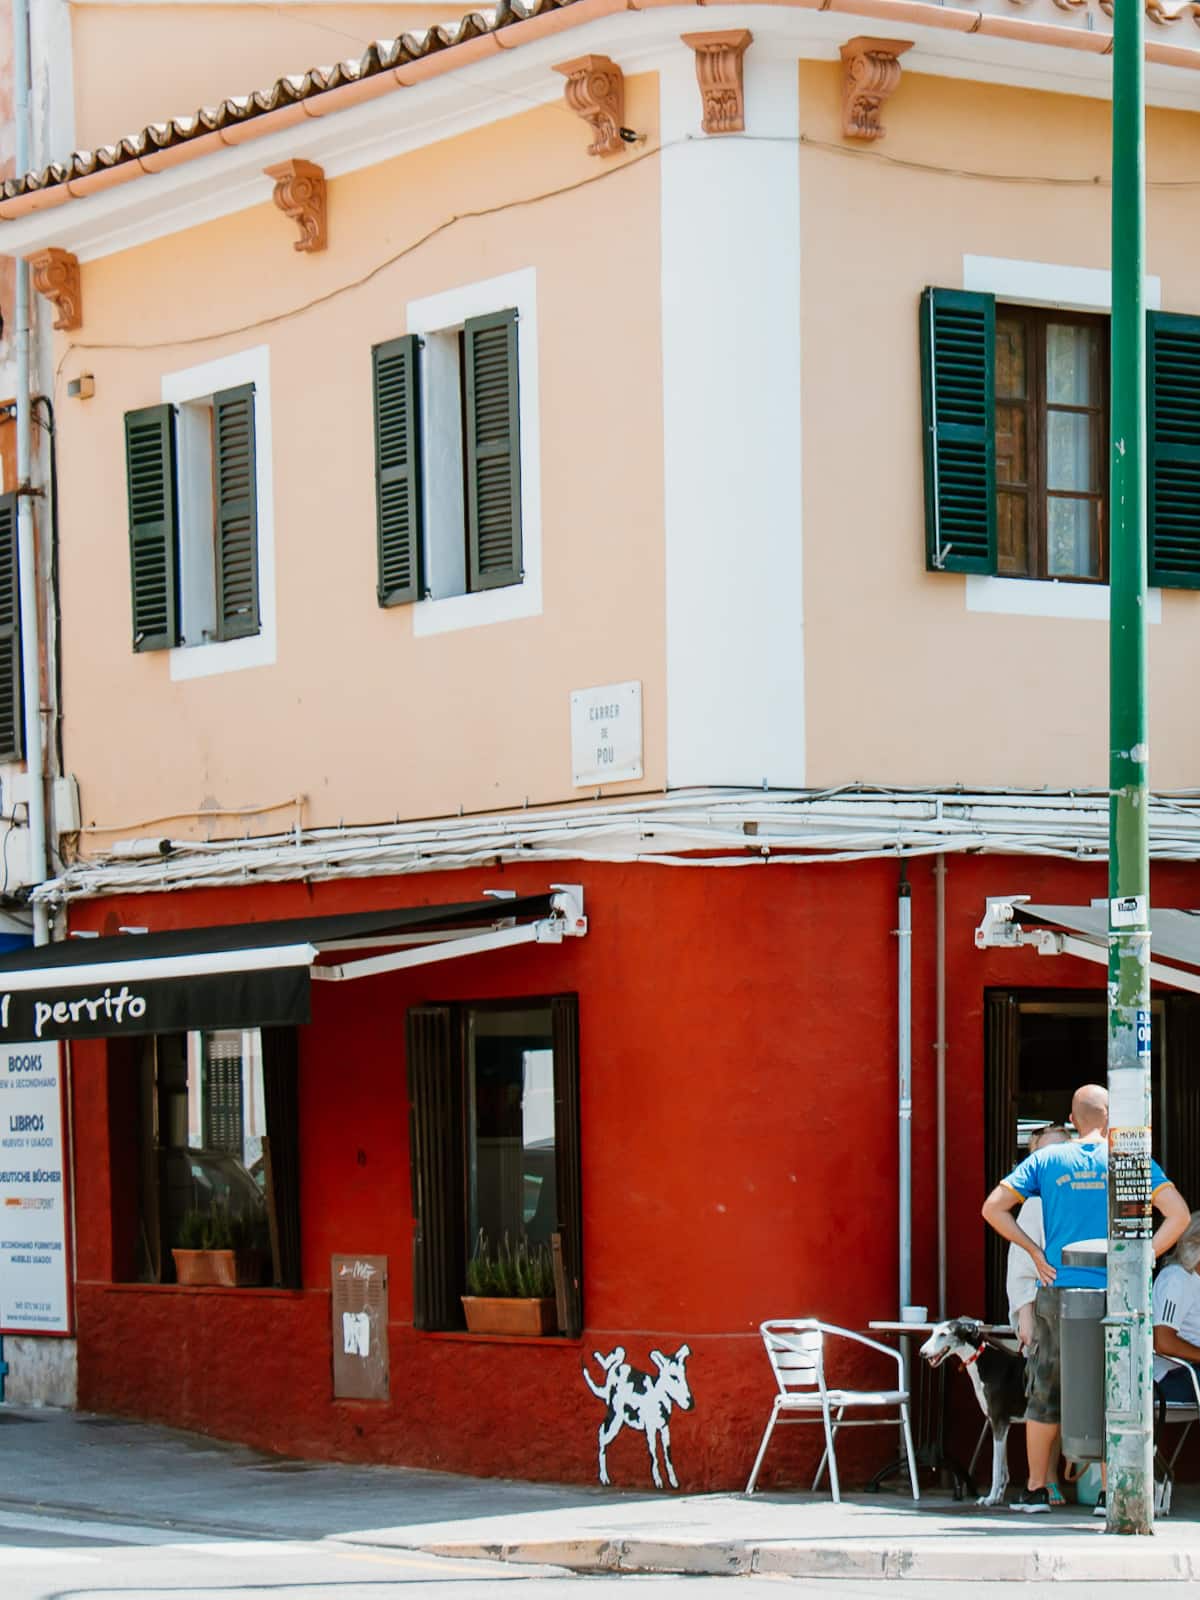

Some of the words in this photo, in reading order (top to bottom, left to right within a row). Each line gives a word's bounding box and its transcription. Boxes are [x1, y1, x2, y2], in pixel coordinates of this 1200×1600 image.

[589, 703, 620, 720] CARRER
[597, 745, 614, 765] POU
[0, 993, 11, 1028] l
[34, 986, 146, 1038] perrito
[8, 1055, 42, 1072] BOOKS
[9, 1114, 44, 1132] LIBROS
